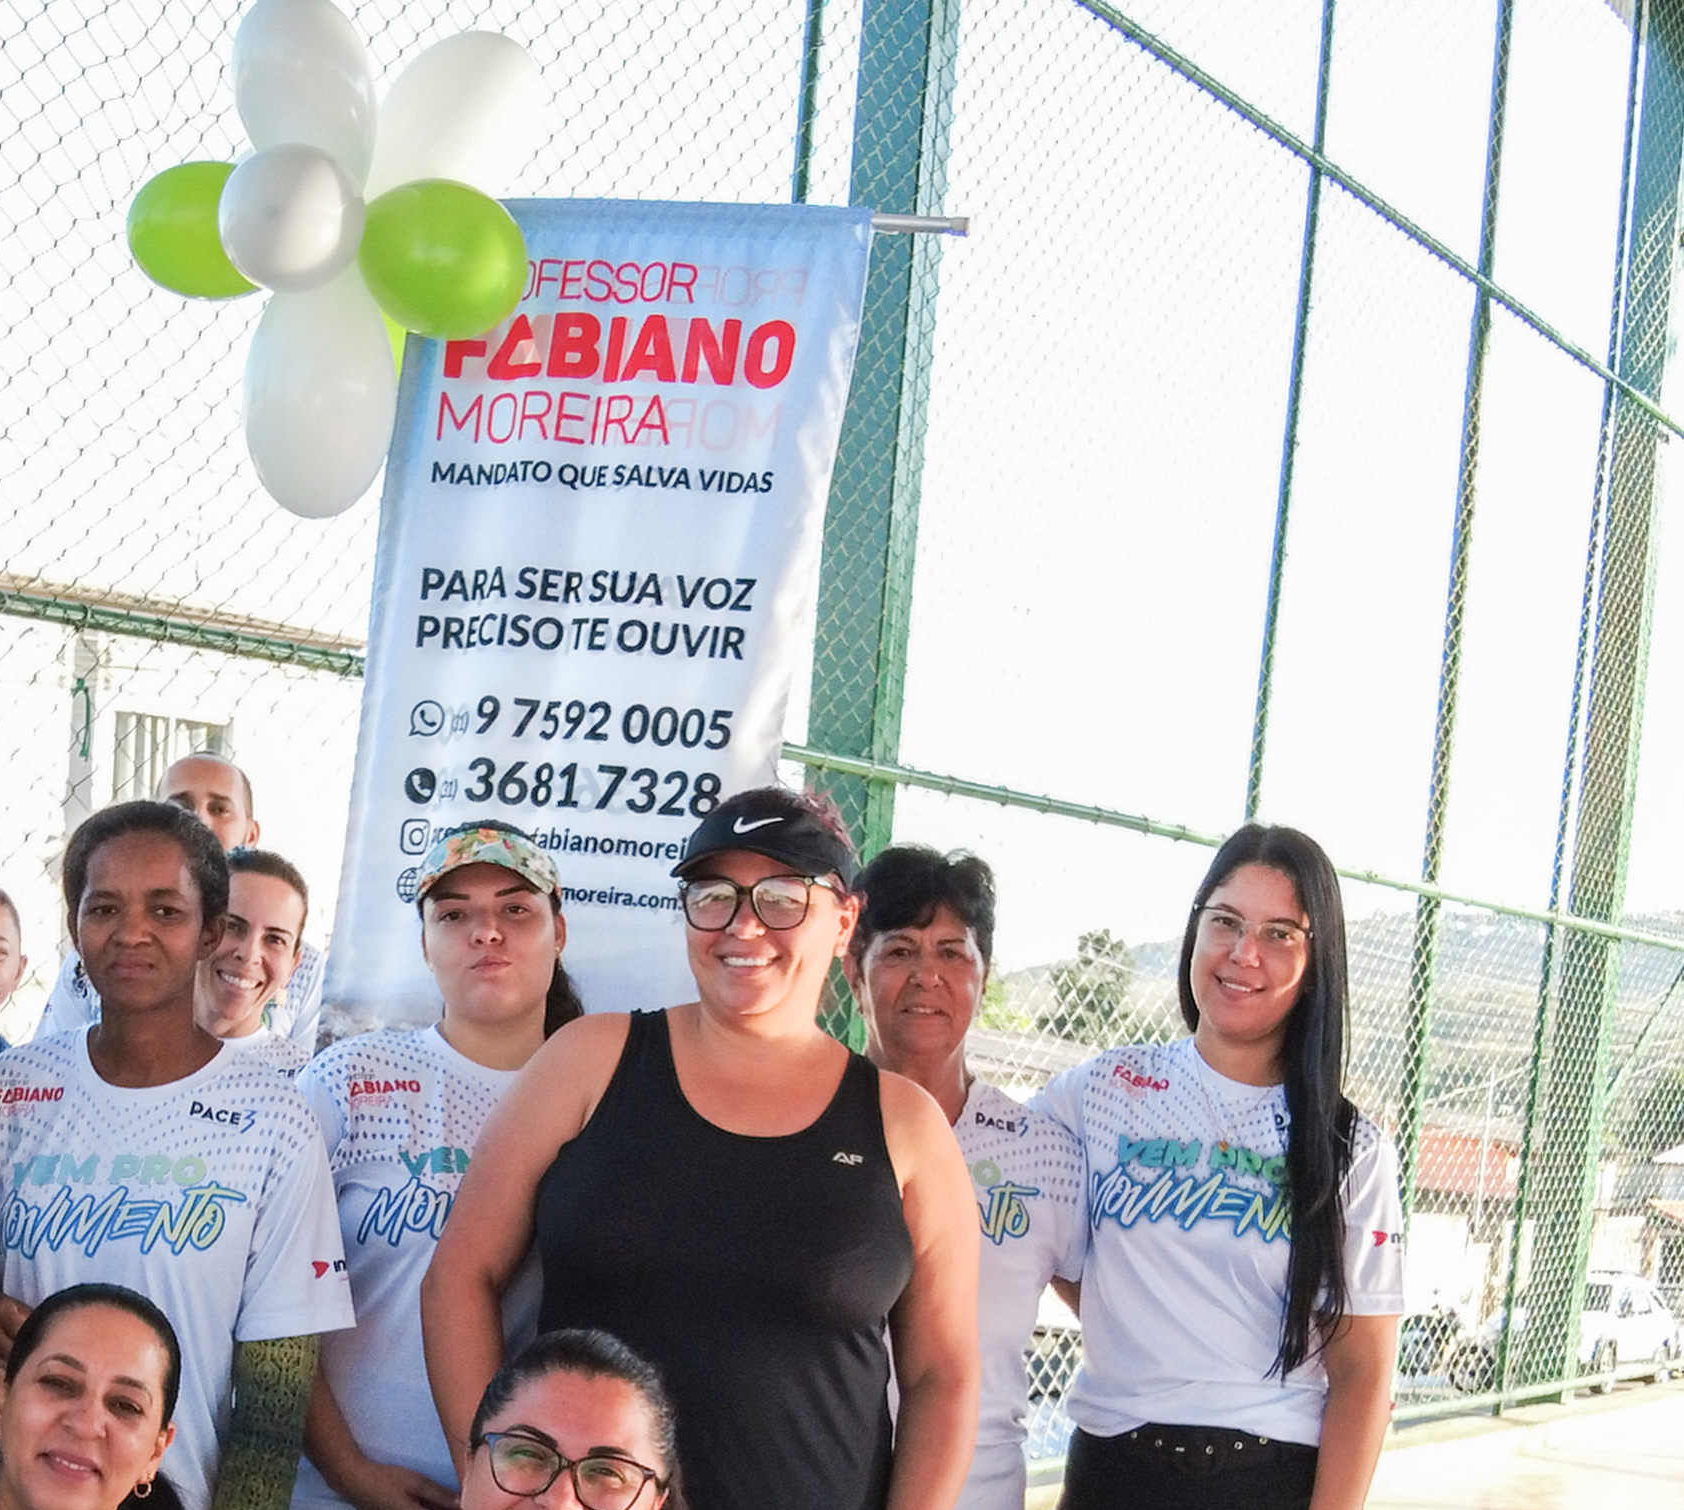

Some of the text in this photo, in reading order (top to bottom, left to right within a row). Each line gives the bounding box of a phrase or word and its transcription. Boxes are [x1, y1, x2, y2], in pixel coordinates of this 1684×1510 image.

[443, 312, 797, 390] FABIANO
[438, 391, 671, 447] MOREIRA
[431, 461, 774, 496] MANDATO QUE SALVA VIDAS
[420, 566, 757, 613] PARA SER SUA VOZ
[416, 615, 747, 661] PRECISO TE OUVIR
[477, 695, 500, 735] 9
[513, 697, 611, 742] 7592
[622, 709, 734, 750] 0005
[465, 756, 578, 809] 3681
[594, 764, 722, 820] 7328
[12, 1153, 209, 1187] VEM PRO
[1116, 1134, 1202, 1170] VEM
